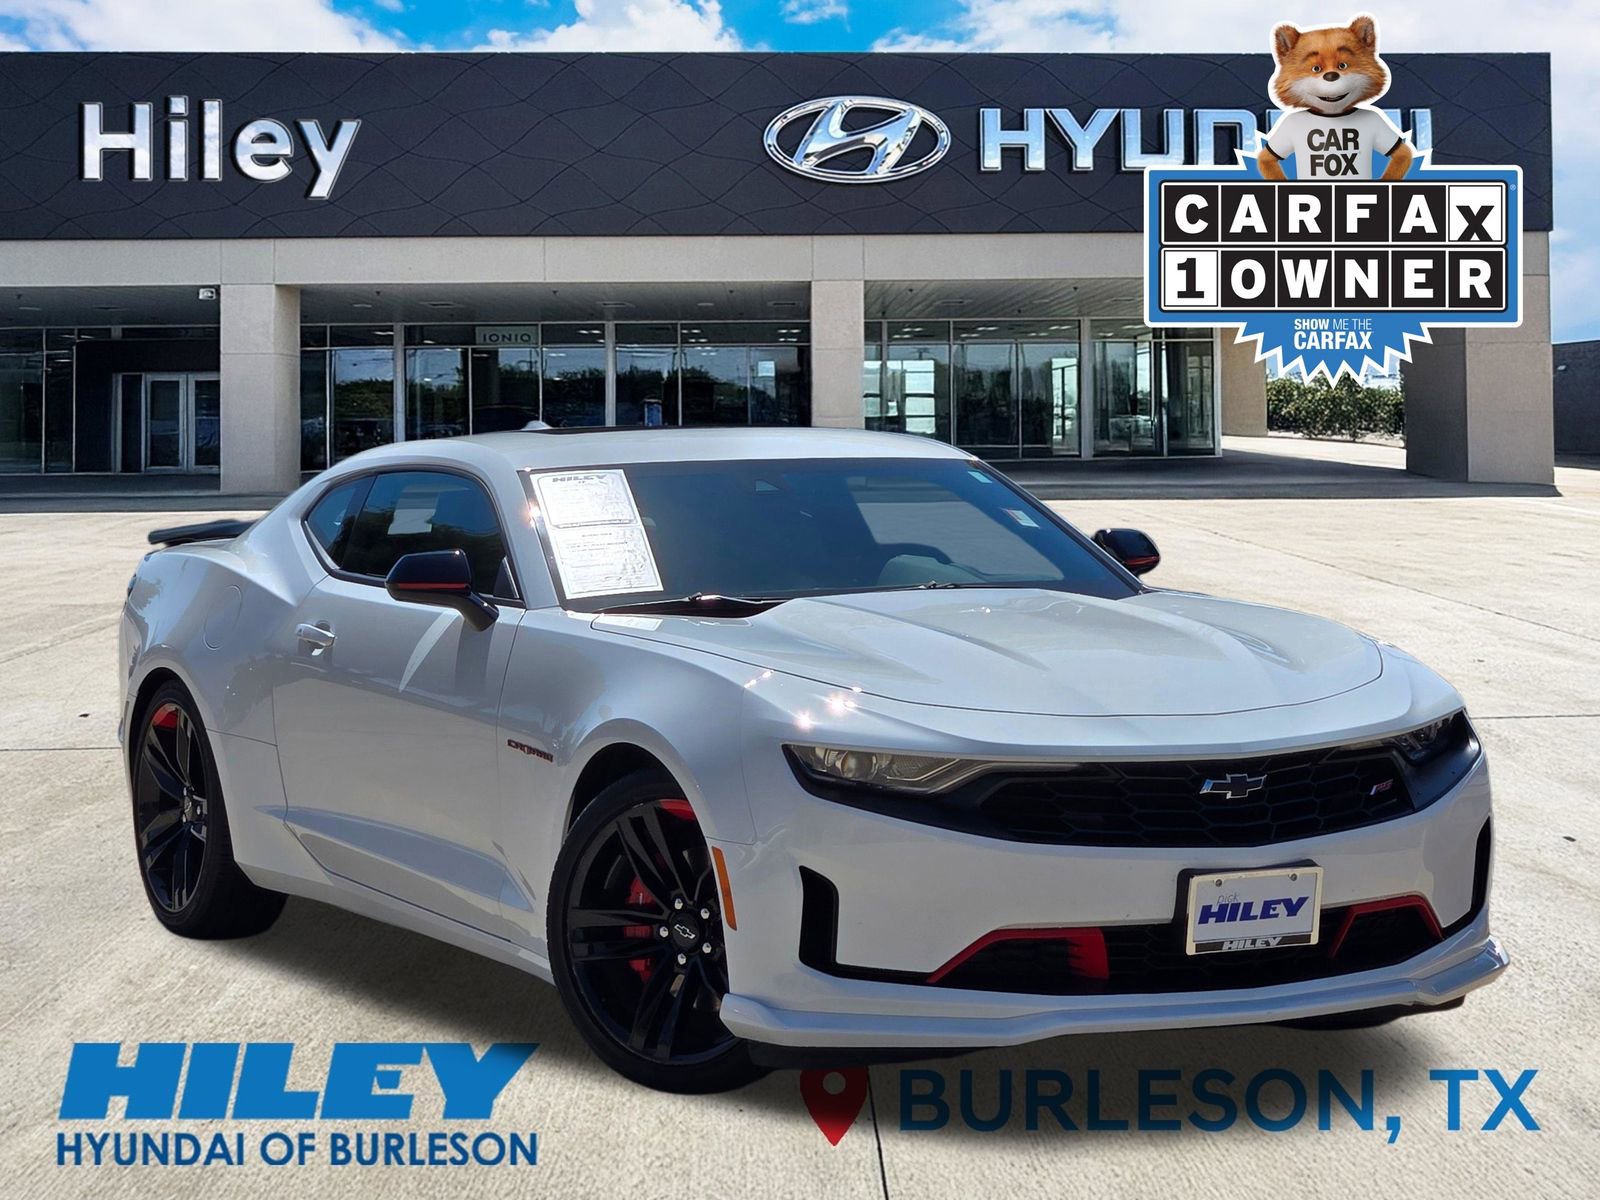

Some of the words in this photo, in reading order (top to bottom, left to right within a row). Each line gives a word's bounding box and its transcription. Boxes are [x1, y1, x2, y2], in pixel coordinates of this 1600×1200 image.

[80, 95, 361, 199] Hiley
[483, 333, 531, 343] IONIQ
[1198, 896, 1309, 925] HILEY
[1222, 937, 1282, 951] HILEY
